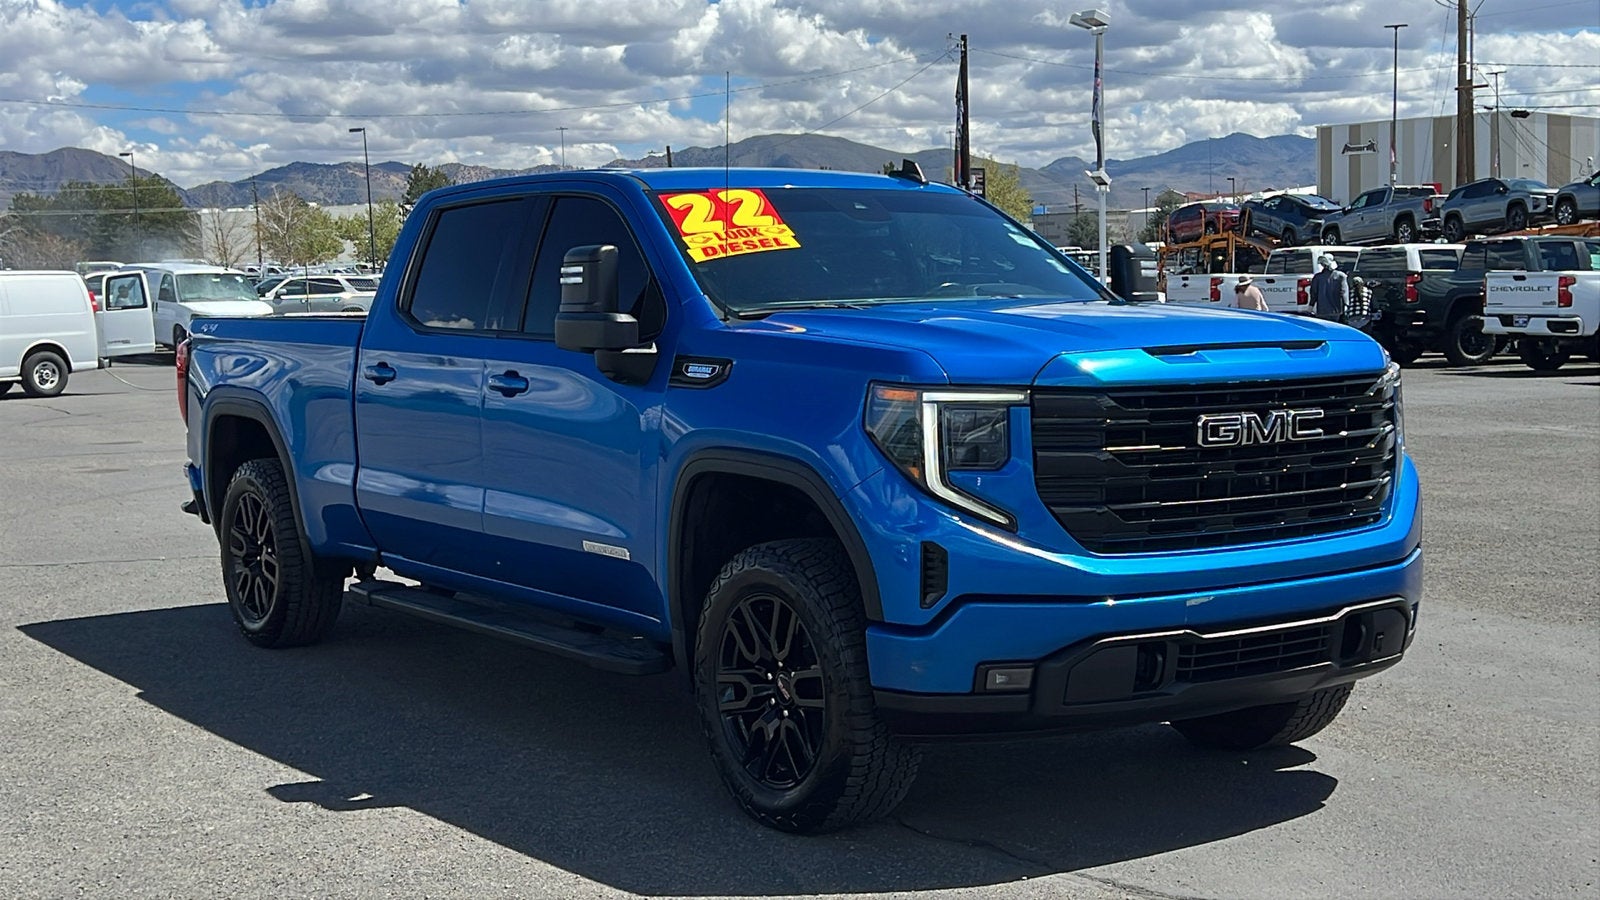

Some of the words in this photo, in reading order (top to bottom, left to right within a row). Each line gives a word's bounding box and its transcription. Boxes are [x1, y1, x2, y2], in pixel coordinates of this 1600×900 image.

[667, 189, 774, 234] 22
[702, 237, 788, 257] DIESEL
[714, 227, 762, 241] LOOK
[1197, 407, 1325, 447] GMC
